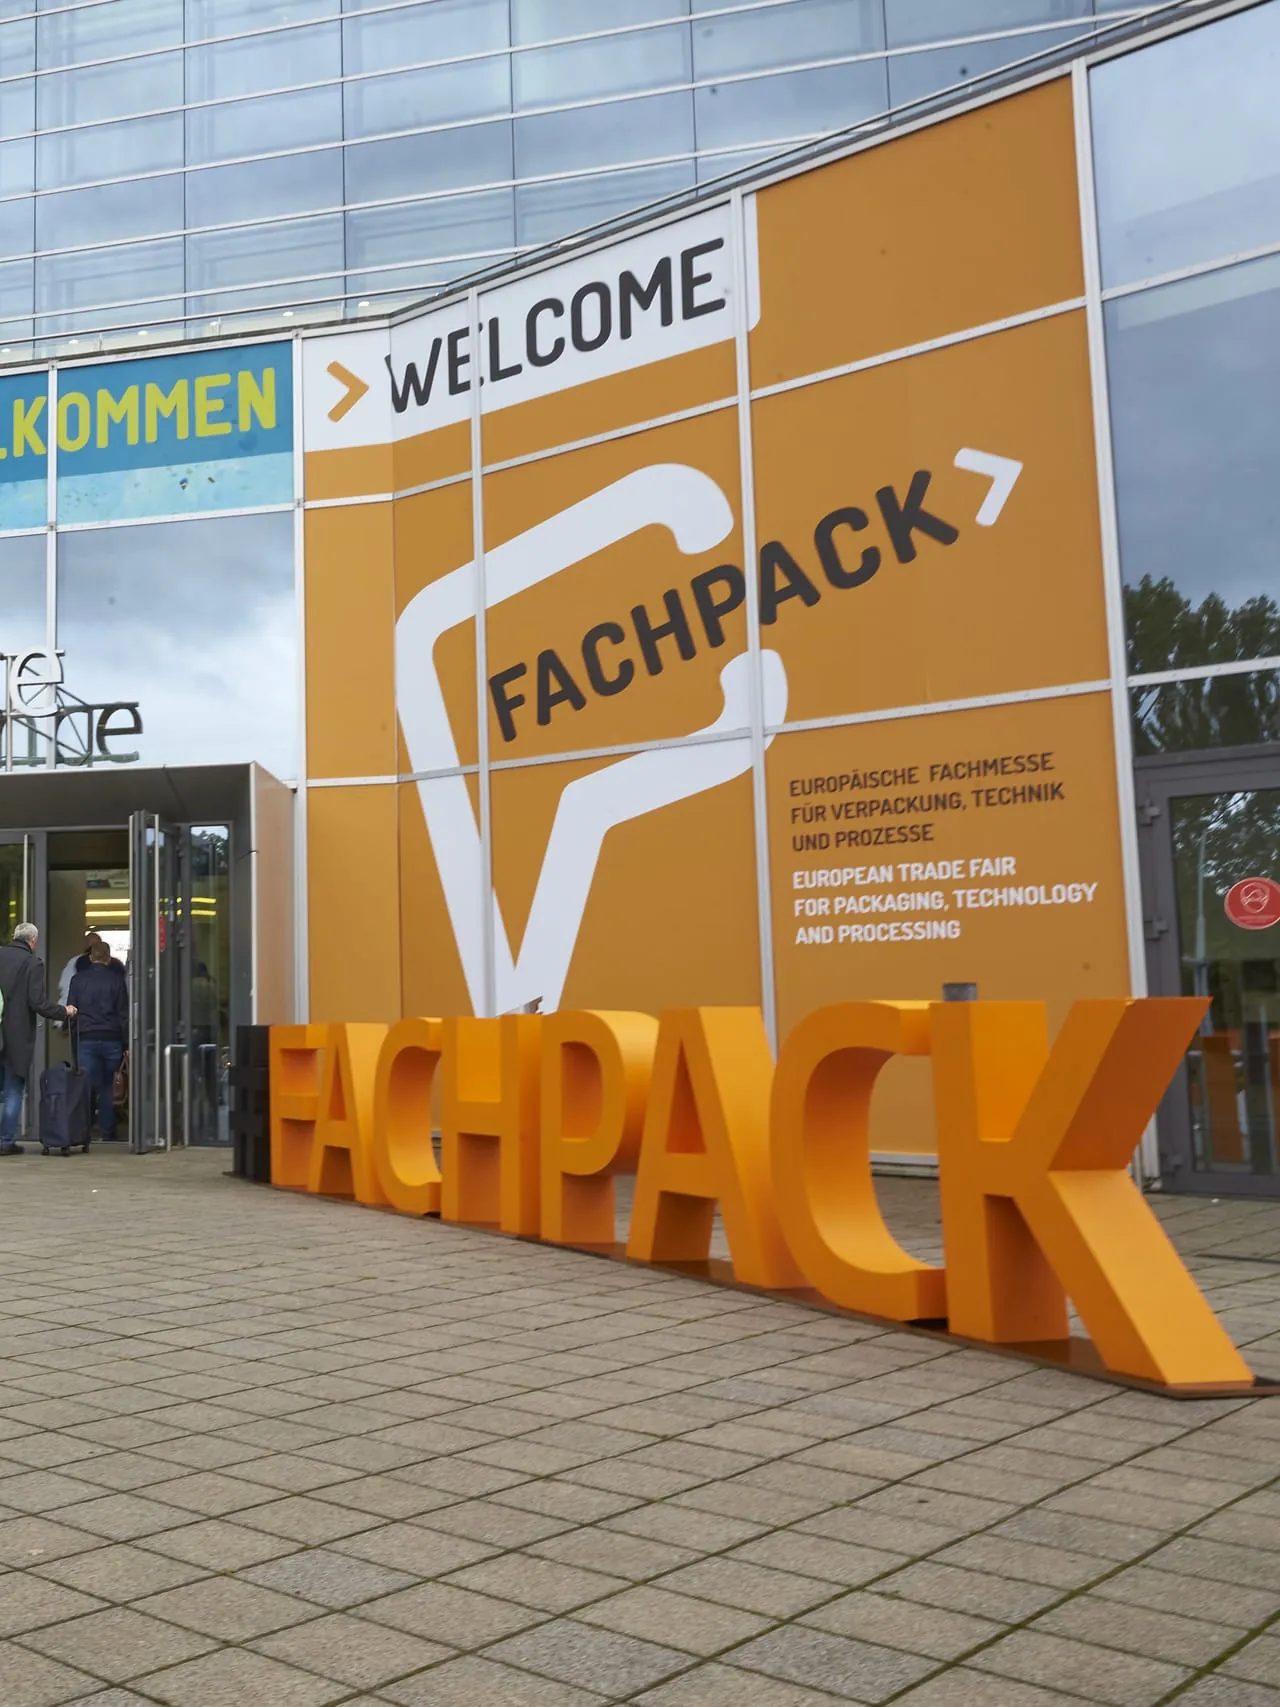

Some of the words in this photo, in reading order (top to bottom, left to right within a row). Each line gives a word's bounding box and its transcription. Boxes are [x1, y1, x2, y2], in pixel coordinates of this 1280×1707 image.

[385, 237, 726, 413] WELCOME
[489, 470, 960, 742] FACHPACK
[790, 767, 919, 797] EUROPÄISCHE
[929, 752, 1055, 782] FACHMESSE
[790, 802, 826, 825] FÜR
[831, 792, 966, 820] VERPACKUNG,
[971, 782, 1066, 808] TECHNIK
[792, 833, 830, 852] UND
[835, 823, 935, 849] PROZESSE
[793, 864, 893, 889] EUROPEAN
[897, 859, 966, 883] TRADE
[969, 856, 1017, 877] FAIR
[794, 896, 830, 917] FOR
[834, 889, 950, 915] PACKAGING,
[952, 882, 1098, 909] TECHNOLOGY
[795, 925, 834, 945] AND
[838, 919, 961, 943] PROCESSING
